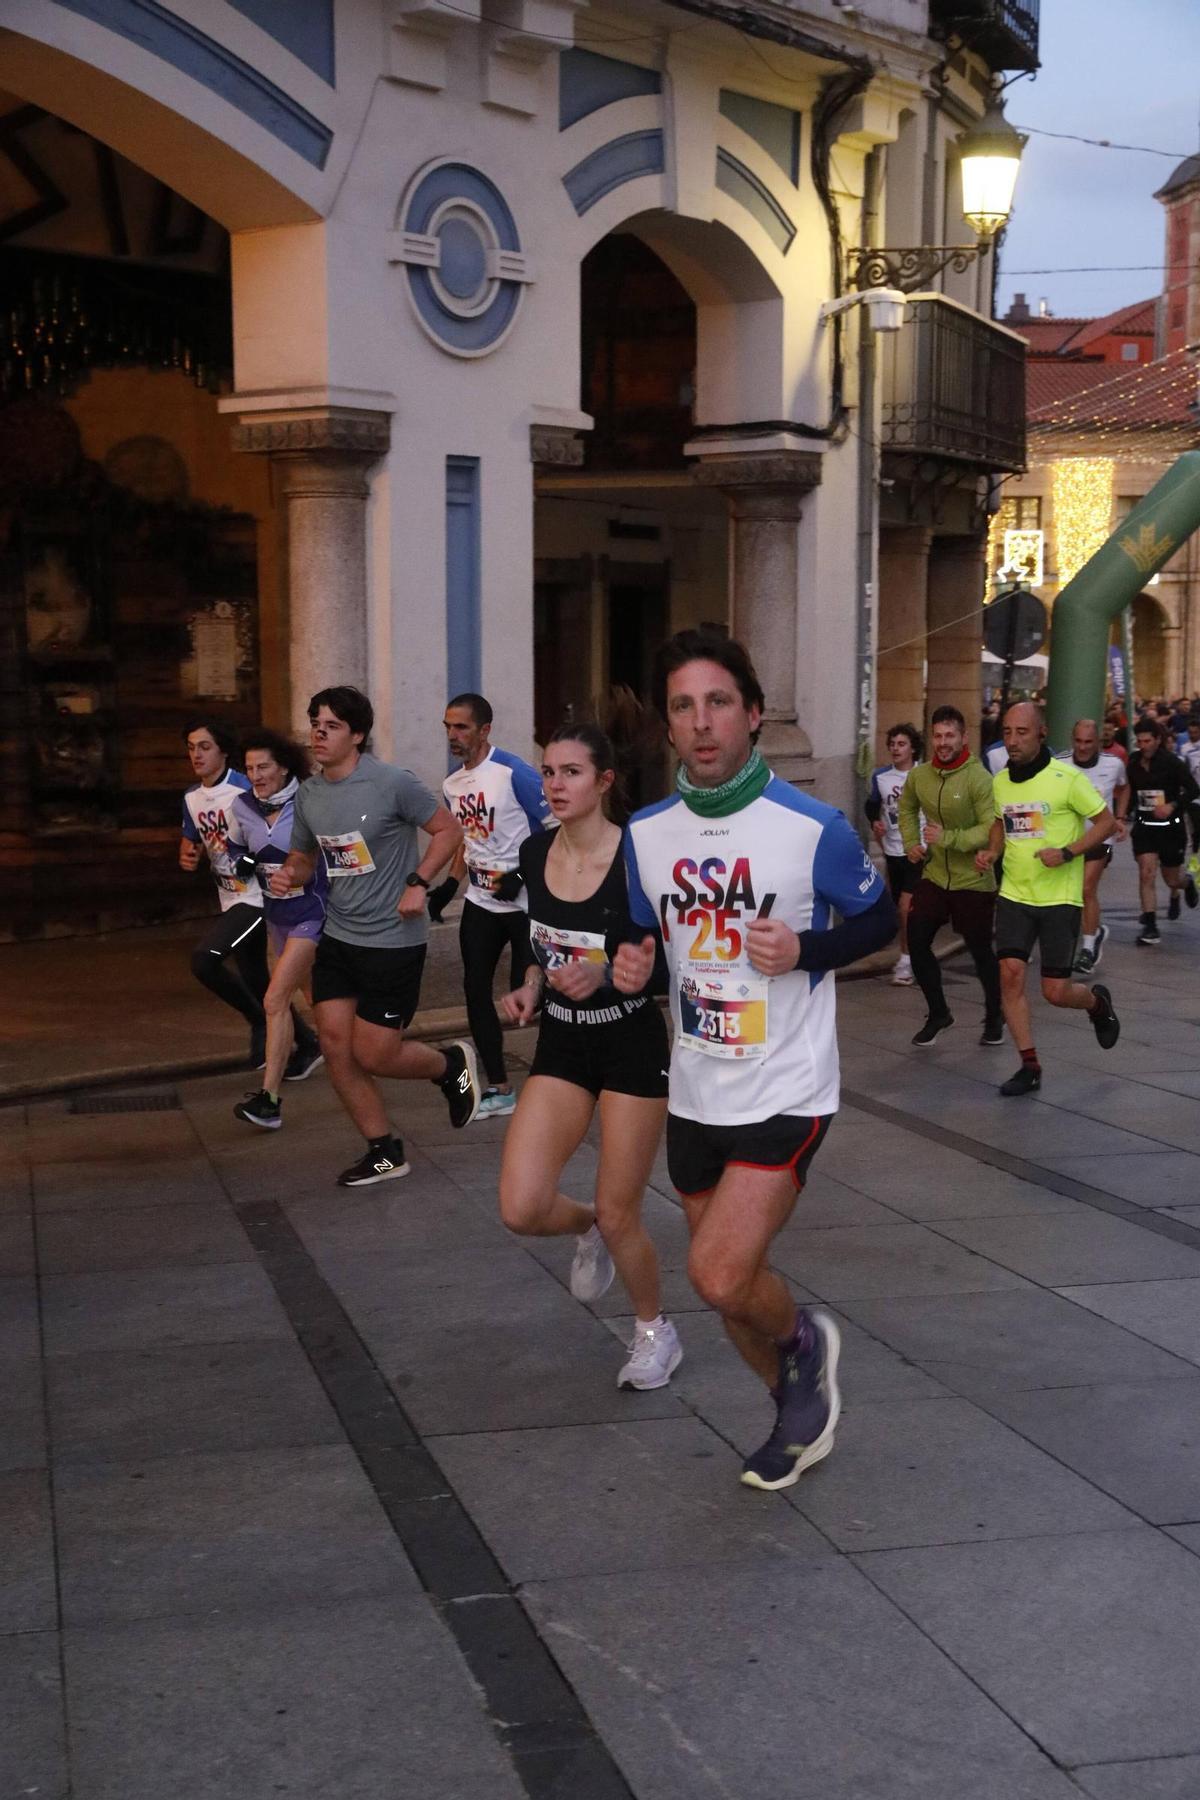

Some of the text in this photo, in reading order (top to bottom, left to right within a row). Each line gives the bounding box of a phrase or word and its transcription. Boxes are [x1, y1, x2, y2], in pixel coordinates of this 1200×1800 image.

[458, 792, 488, 819] SSA
[197, 809, 229, 835] SSA
[331, 850, 360, 866] 2485
[671, 857, 757, 911] SSA
[577, 1005, 623, 1025] PUMA
[695, 1007, 741, 1039] 2313
